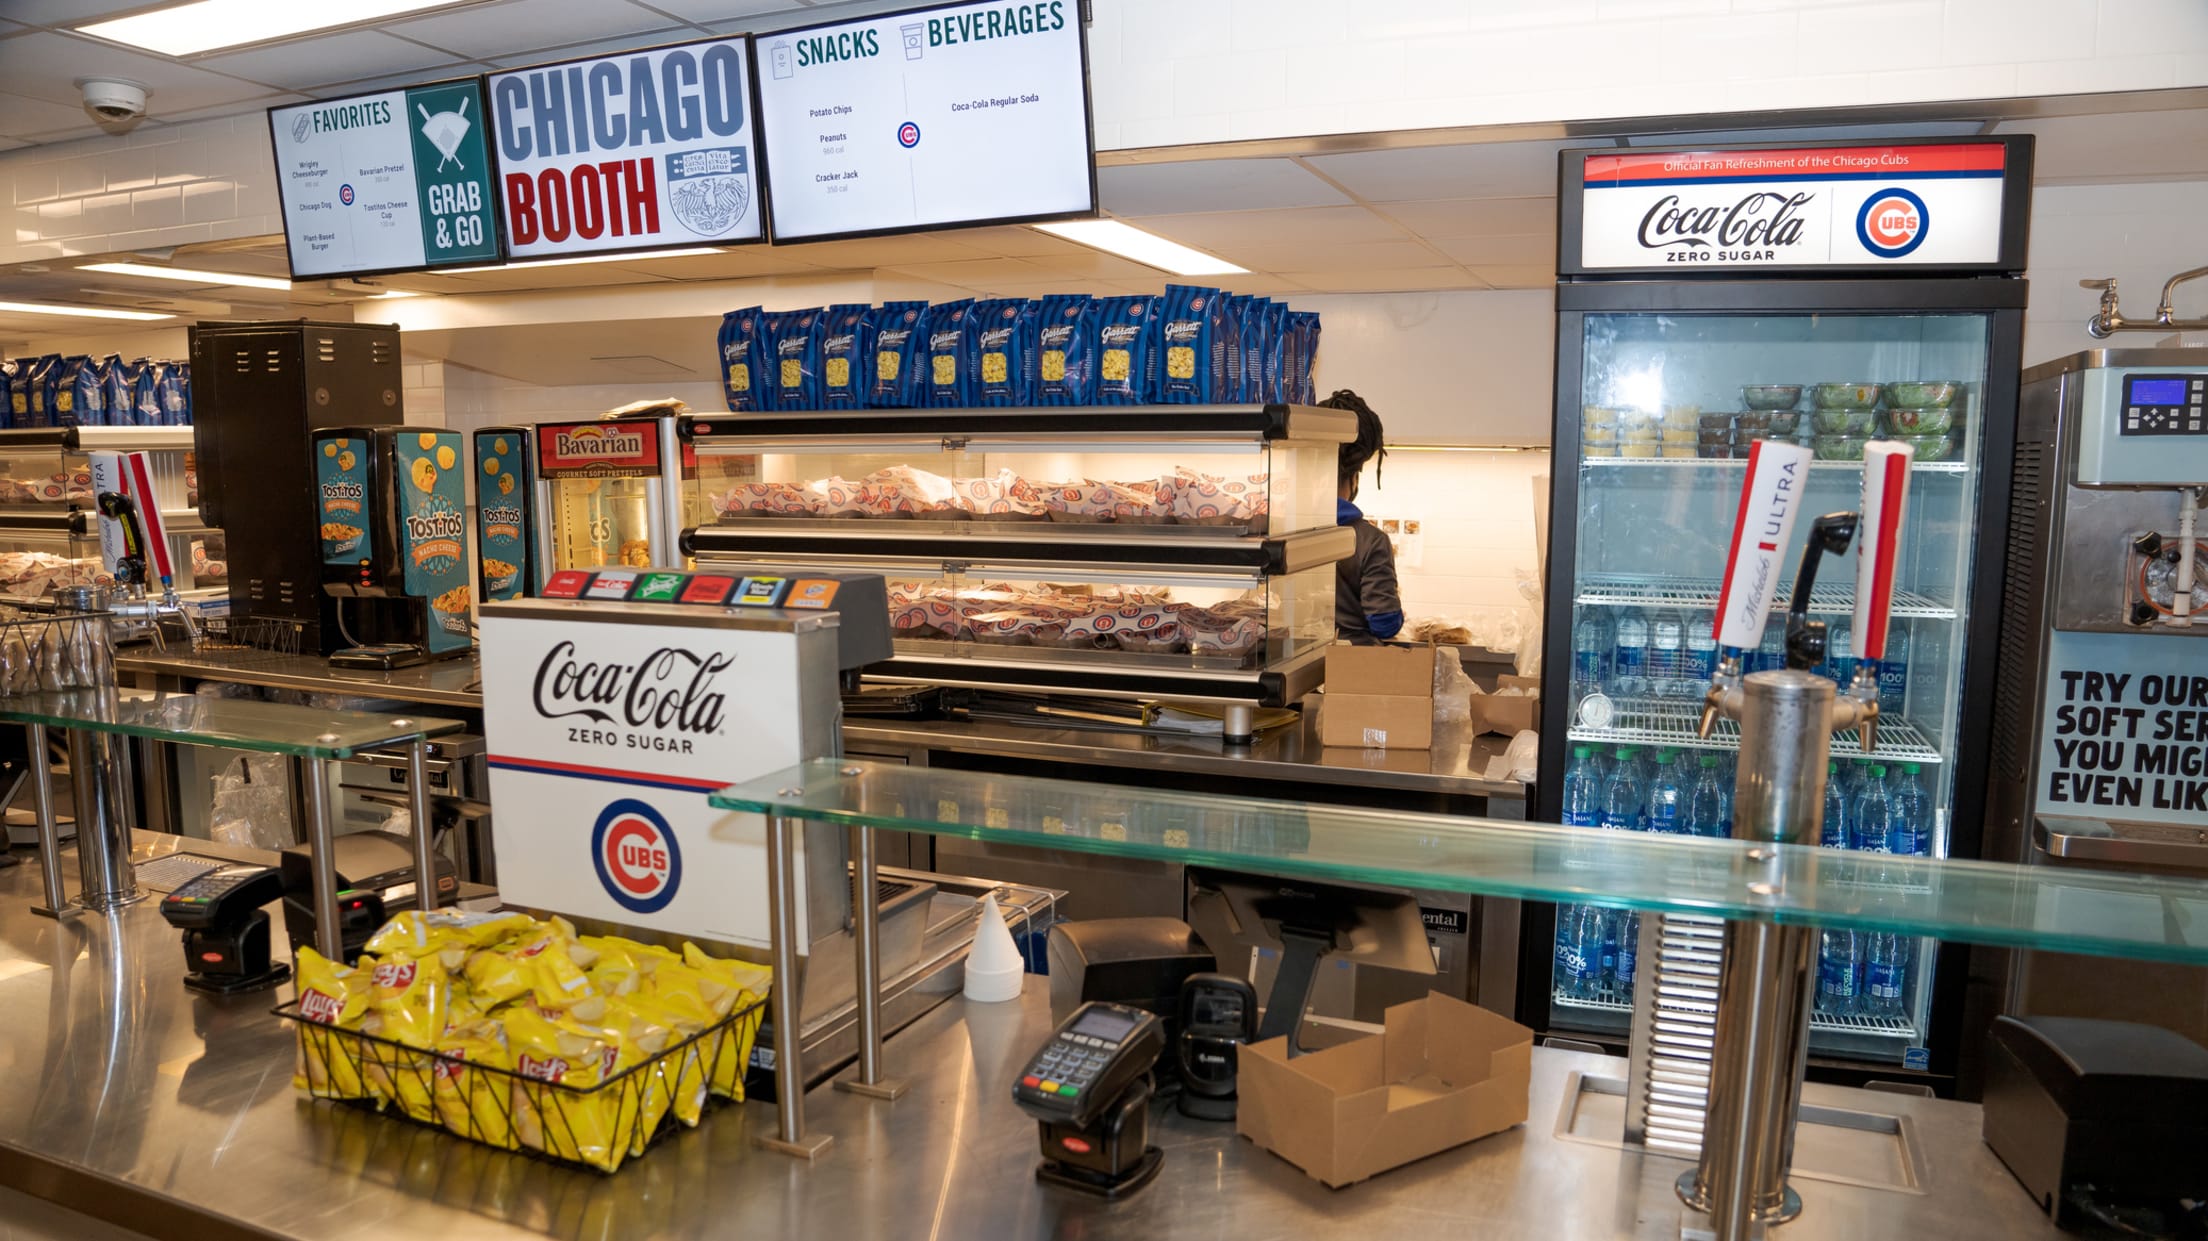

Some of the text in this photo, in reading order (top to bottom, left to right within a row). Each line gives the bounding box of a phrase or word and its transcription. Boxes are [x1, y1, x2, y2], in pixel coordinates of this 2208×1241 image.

[928, 1, 1065, 47] BEVERAGES
[796, 28, 880, 67] SNACKS
[313, 100, 391, 133] FAVORITES
[496, 44, 744, 161] CHICAGO
[810, 105, 852, 117] Potato Chips
[951, 93, 1039, 112] Coca-Cola Regular Soda
[820, 133, 847, 143] Peanuts
[292, 169, 328, 179] Cheeseburger
[360, 164, 404, 176] Bavarian Pretzel
[816, 170, 859, 182] Cracker Jack
[1664, 154, 1909, 172] Official Fan Refreshment of the Chicago Cubs
[299, 201, 332, 211] Chicago Dog
[387, 201, 408, 209] Cheese
[428, 181, 482, 216] GRAB
[506, 157, 660, 246] BOOTH
[436, 214, 484, 248] & GO
[1637, 192, 1817, 248] Coca-Cola
[312, 243, 329, 251] Burger
[1667, 249, 1775, 262] ZERO SUGAR
[557, 434, 641, 456] Bavarian
[557, 470, 588, 478] GOURMET
[607, 469, 642, 477] PRETZELS
[1765, 460, 1798, 537] ULTRA
[1741, 557, 1771, 631] Michelob
[533, 640, 737, 735] Coca-Cola
[2061, 671, 2208, 707] TRY OUR
[2057, 705, 2145, 738] SOFT
[568, 728, 693, 754] ZERO SUGAR
[2054, 739, 2124, 771] YOU
[2050, 772, 2143, 807] EVEN
